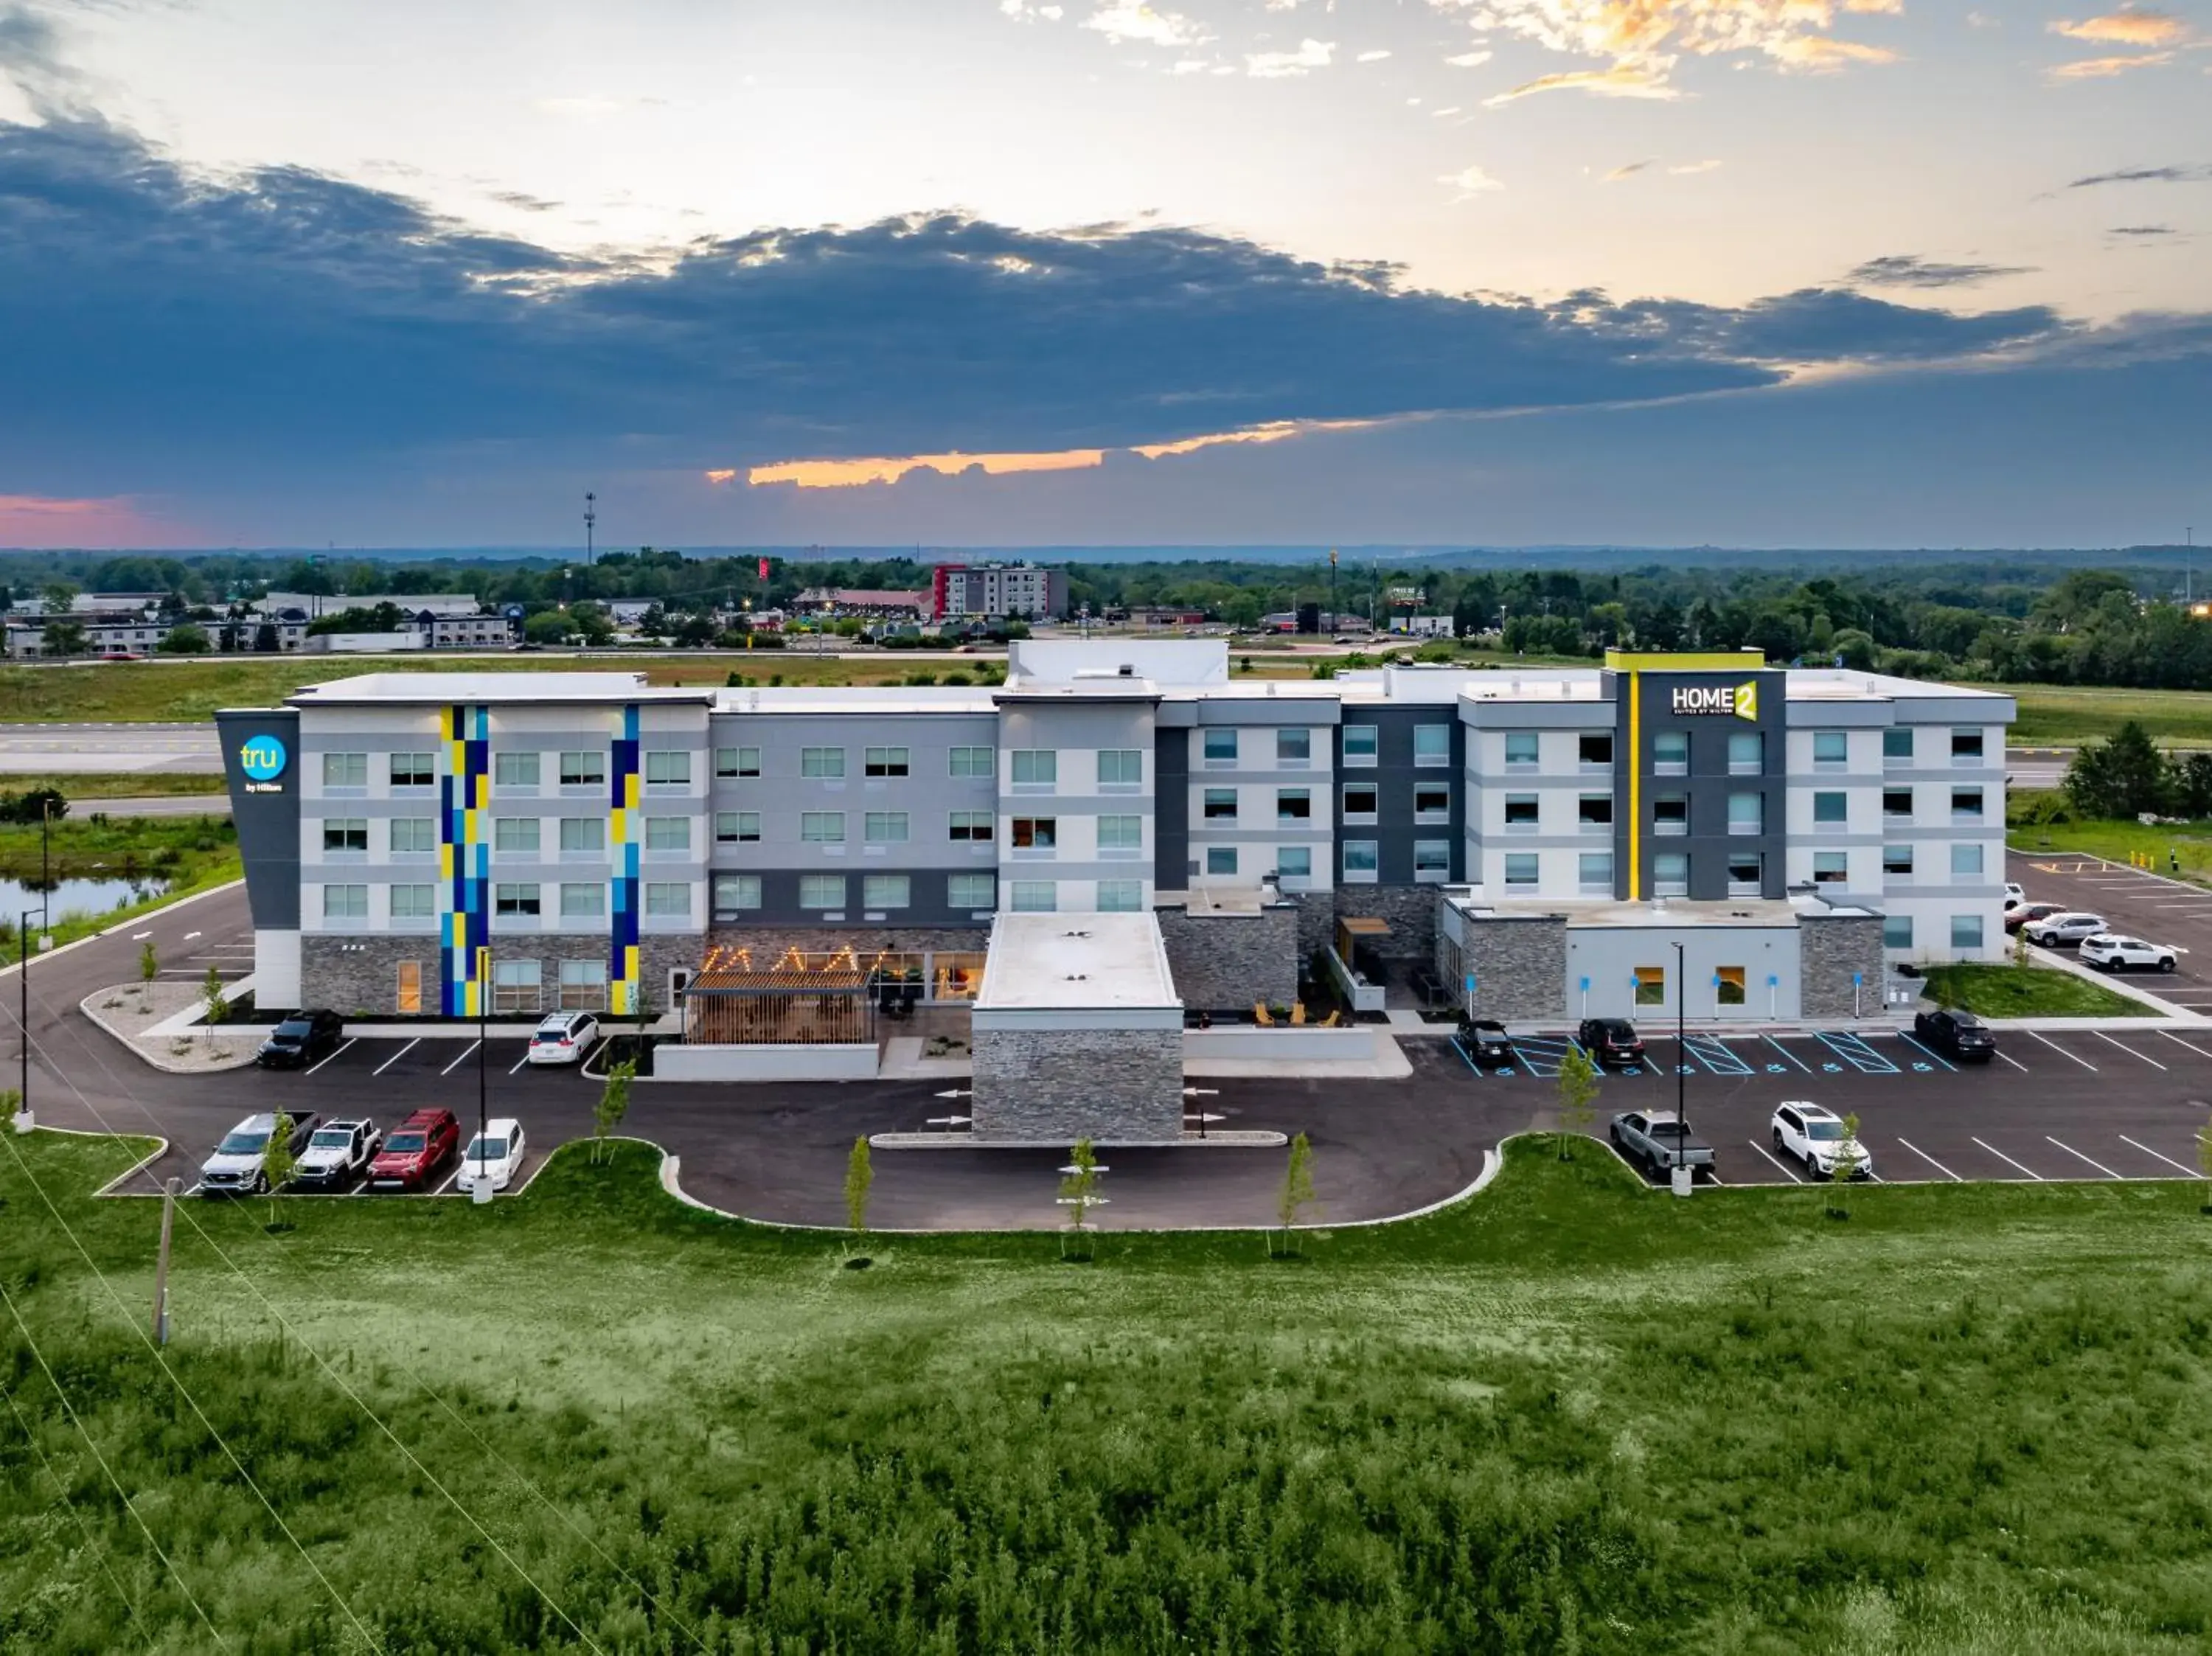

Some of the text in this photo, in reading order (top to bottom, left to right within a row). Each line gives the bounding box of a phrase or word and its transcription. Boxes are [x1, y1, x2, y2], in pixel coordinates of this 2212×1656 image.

[240, 745, 276, 768] tru
[246, 783, 282, 793] by Hilton
